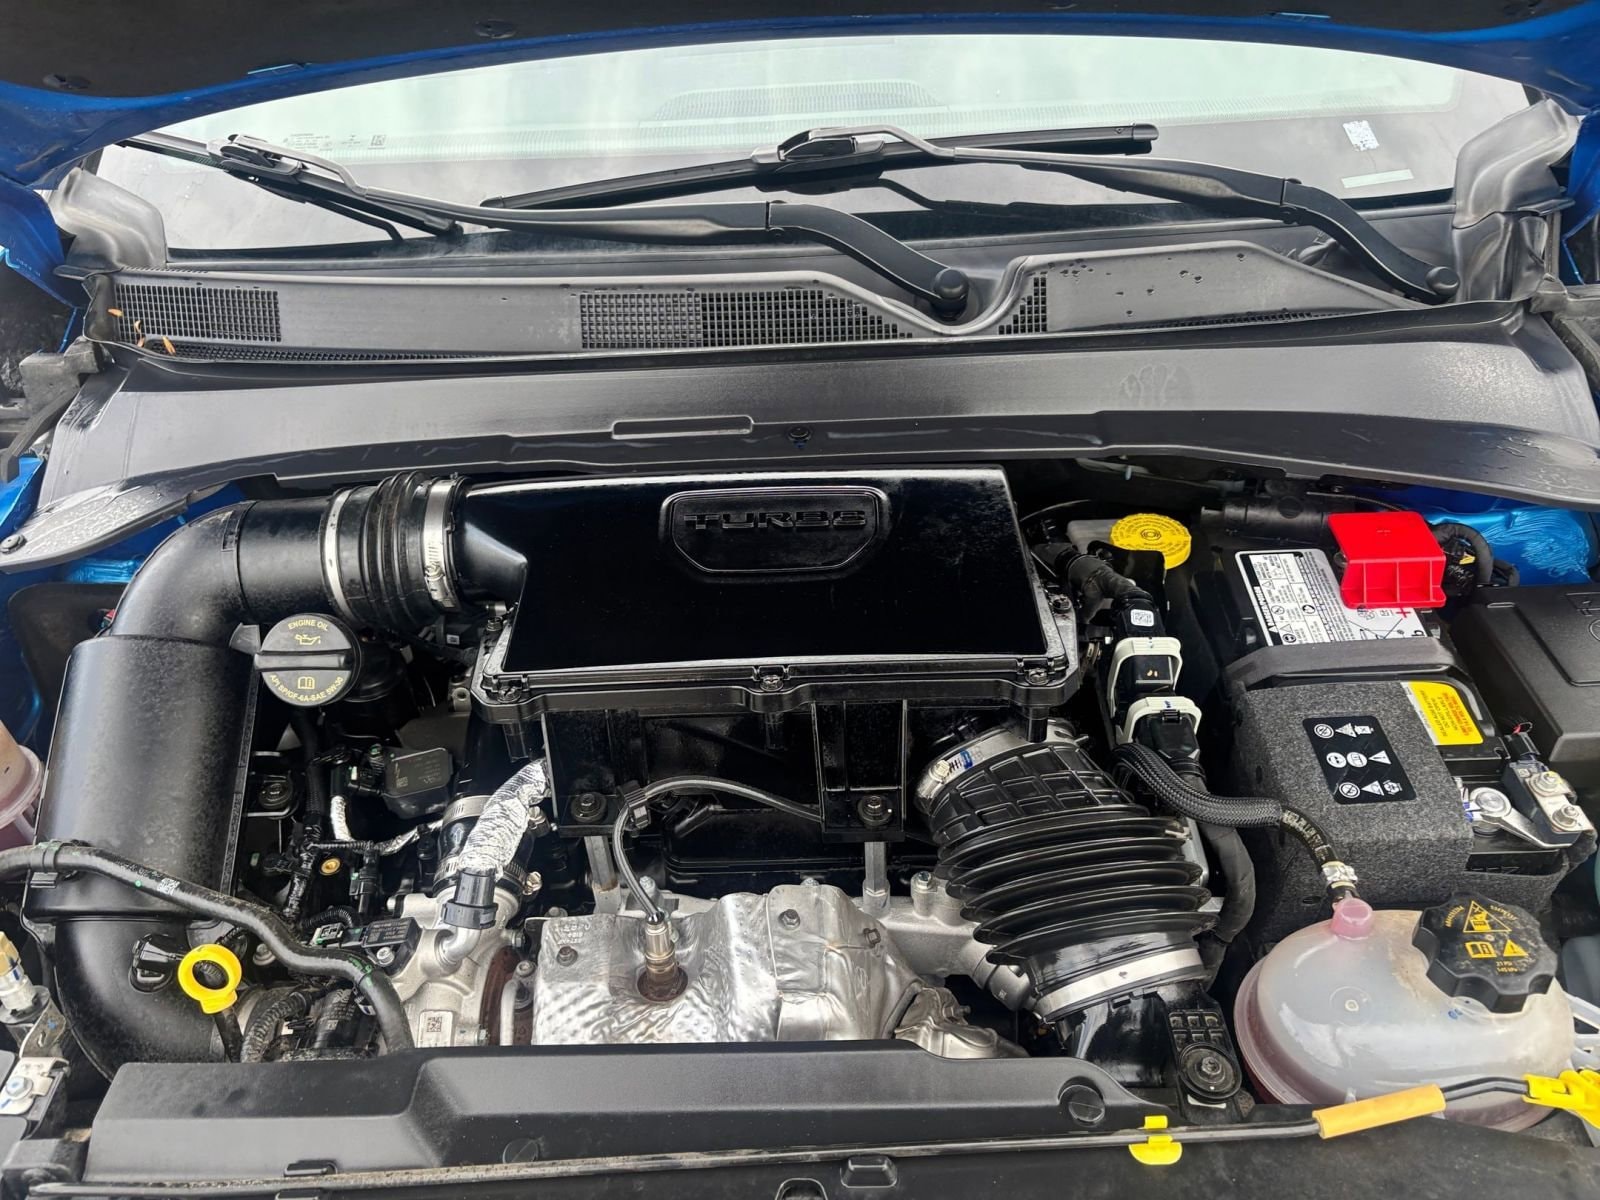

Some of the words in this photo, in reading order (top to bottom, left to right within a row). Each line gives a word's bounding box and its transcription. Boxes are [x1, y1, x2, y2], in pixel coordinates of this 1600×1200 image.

[683, 511, 866, 530] TURBO
[288, 619, 316, 630] ENGINE
[317, 620, 329, 632] OIL
[269, 674, 280, 687] API
[326, 676, 344, 695] 5W-30
